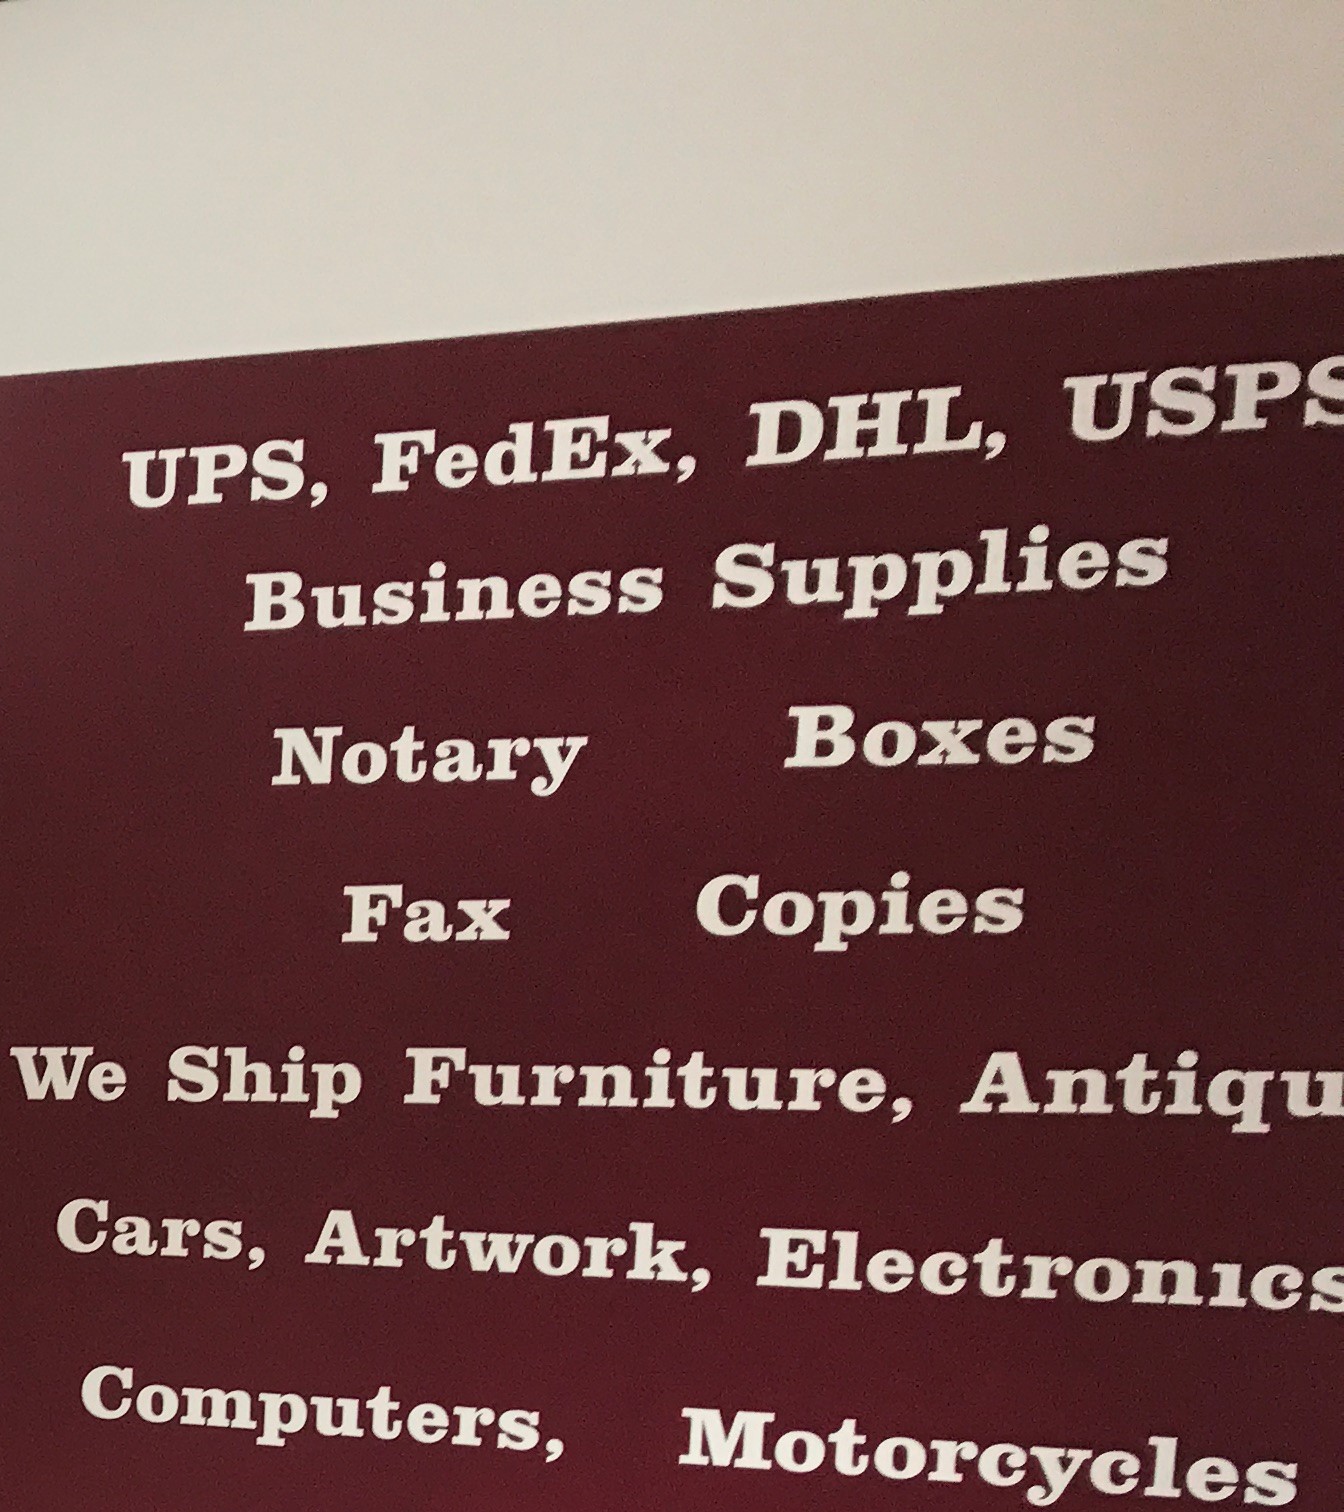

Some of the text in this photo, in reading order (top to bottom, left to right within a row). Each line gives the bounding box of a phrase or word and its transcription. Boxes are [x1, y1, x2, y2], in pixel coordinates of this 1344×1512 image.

[120, 437, 329, 510] UPS,
[370, 413, 698, 495] FedEx,
[744, 384, 1007, 468] DHL,
[242, 522, 1170, 633] Business Supplies
[270, 703, 1097, 798] Notary Boxes
[340, 869, 1025, 954] Fax Copies
[8, 1044, 1344, 1135] We Ship Furniture, Antiqu
[55, 1197, 266, 1272] Cars,
[303, 1208, 712, 1294] Artwork,
[80, 1364, 1299, 1508] Computers, Motorcycles
